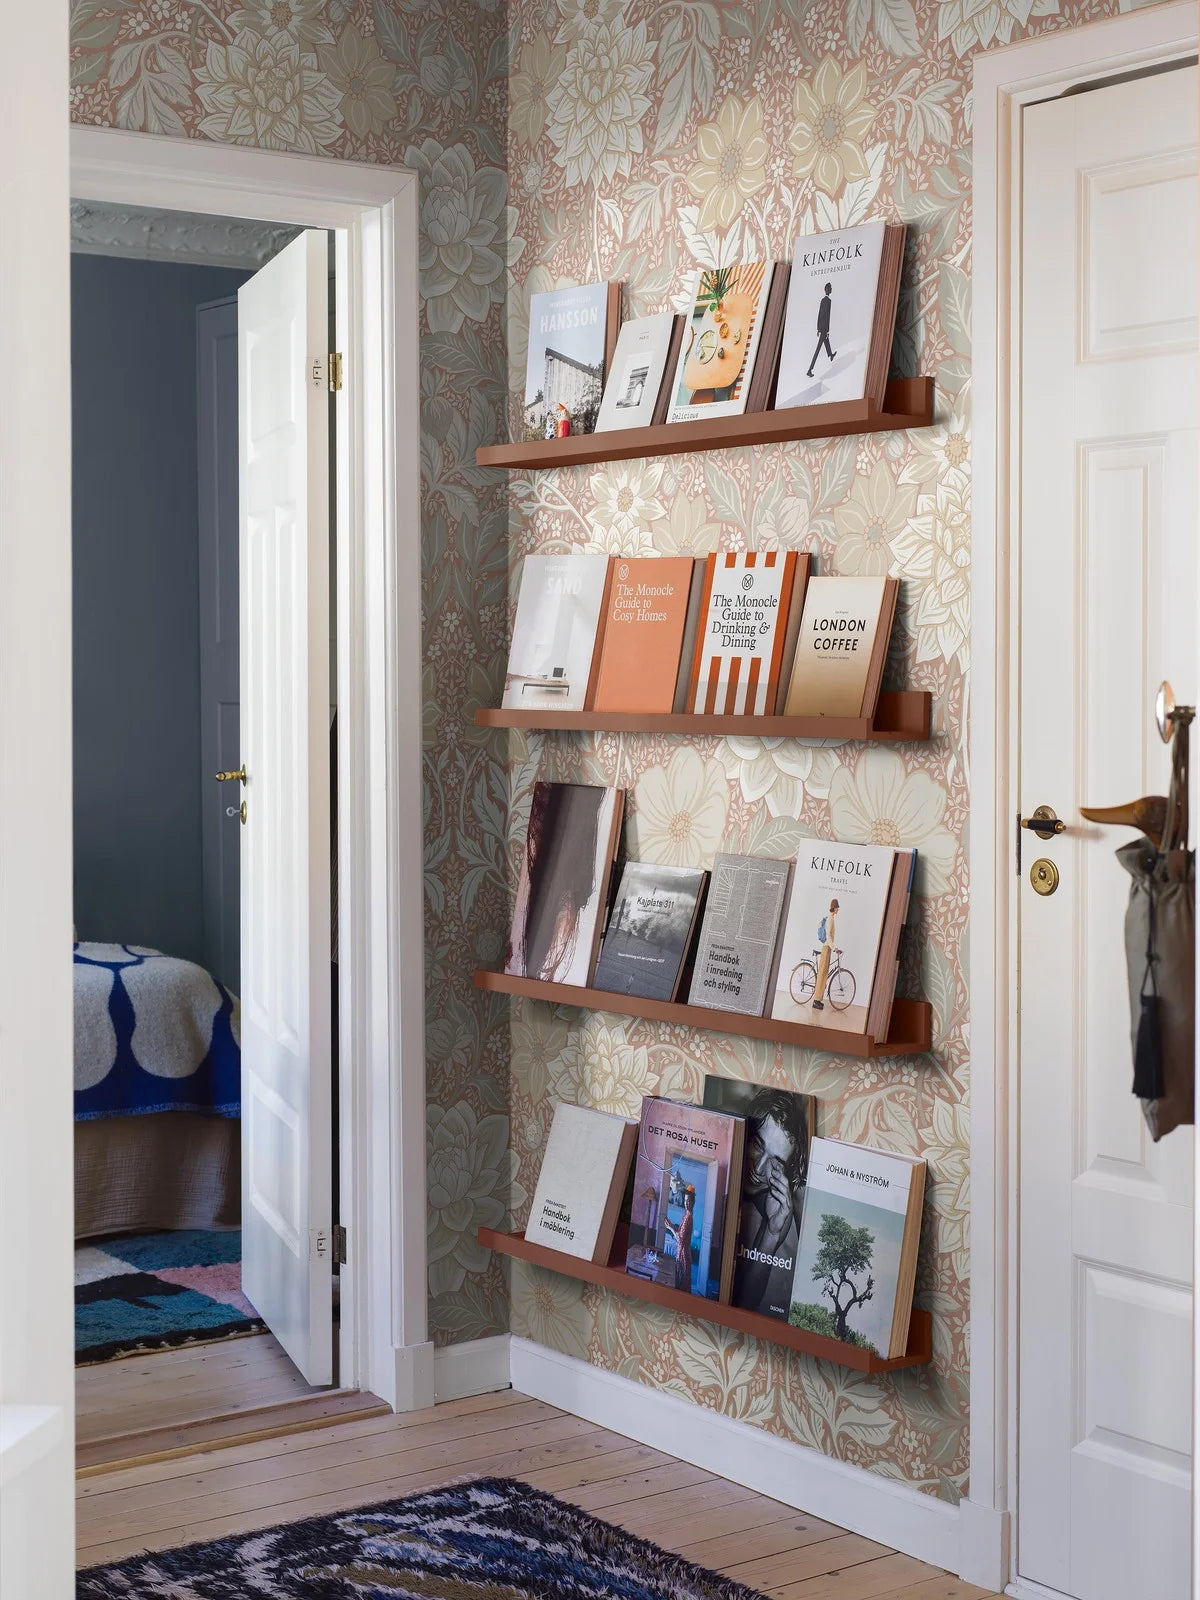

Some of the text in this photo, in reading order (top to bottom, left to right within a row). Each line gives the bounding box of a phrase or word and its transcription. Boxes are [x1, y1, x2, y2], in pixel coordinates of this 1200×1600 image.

[829, 237, 840, 245] THE
[802, 243, 863, 267] KINFOLK
[811, 264, 851, 277] ENTREPRENEUR
[540, 307, 598, 333] HANSSON
[672, 412, 699, 421] Delicious
[617, 583, 674, 596] The Monocle
[615, 596, 652, 609] Guide to
[713, 594, 778, 608] The Monocle
[613, 608, 667, 624] Cosy Homes
[722, 607, 764, 621] Guide to
[712, 621, 771, 637] Drinking &
[813, 619, 866, 632] LONDON
[721, 634, 756, 651] Dining
[814, 637, 859, 651] COFFEE
[811, 856, 873, 877] KINFOLK
[830, 877, 848, 885] TRAVEL
[637, 896, 663, 908] Kajplats
[708, 951, 740, 965] Handbok
[706, 963, 743, 982] i inredning
[703, 978, 741, 996] och styling
[648, 1125, 719, 1151] DET ROSA HUSET
[826, 1164, 849, 1177] JOHAN
[849, 1170, 856, 1179] &
[856, 1171, 890, 1188] NYSTRÖM
[543, 1205, 571, 1223] Handbok
[540, 1217, 575, 1240] i möblering
